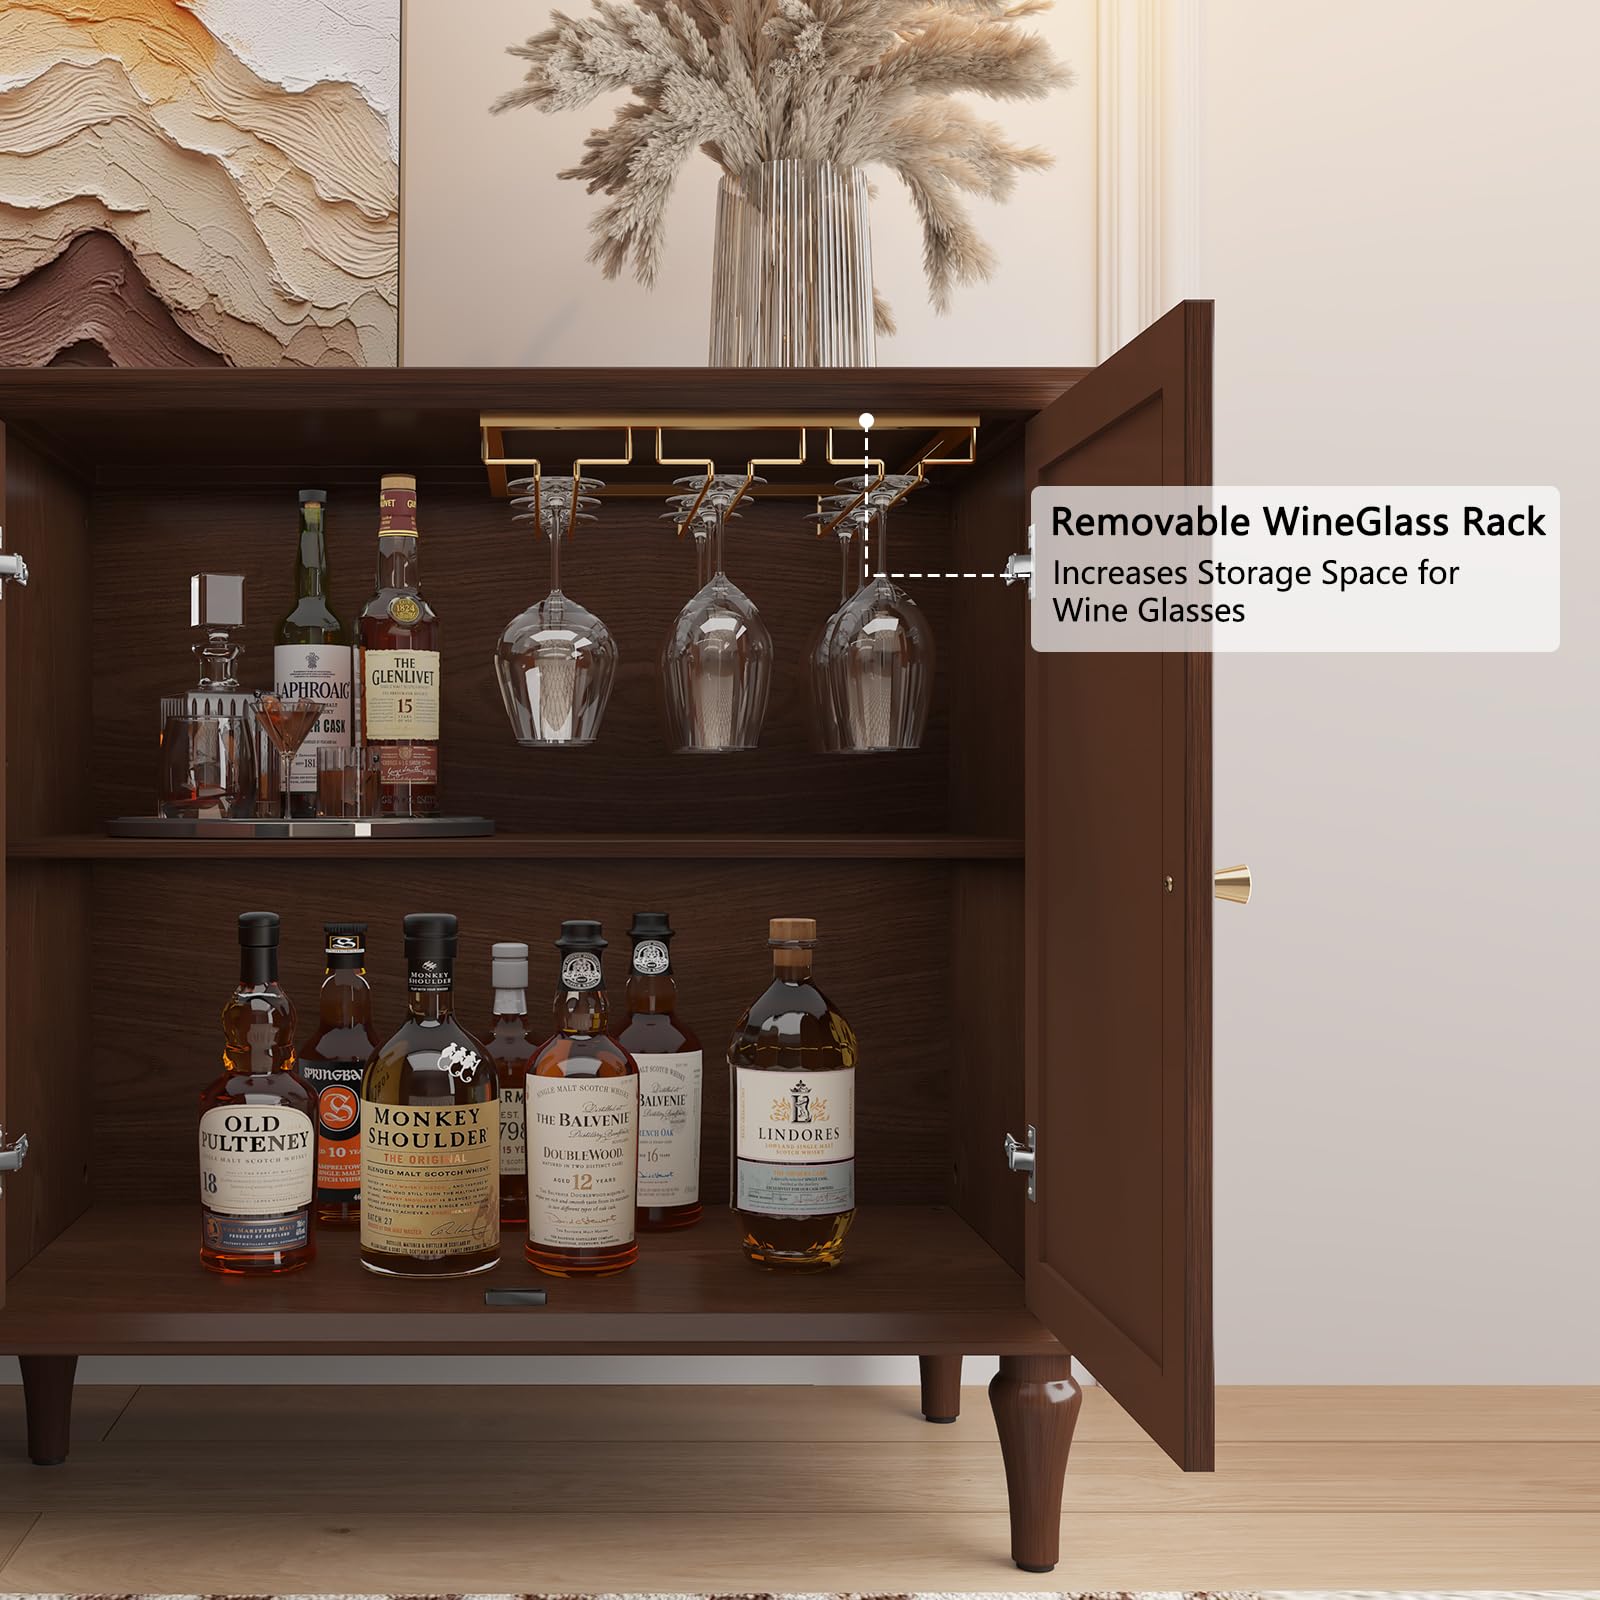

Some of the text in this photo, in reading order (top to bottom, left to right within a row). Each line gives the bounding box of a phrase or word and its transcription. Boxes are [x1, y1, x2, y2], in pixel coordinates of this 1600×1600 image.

[396, 604, 416, 612] 1824
[394, 658, 416, 668] THE
[372, 670, 434, 686] GLENLIVET
[398, 698, 413, 713] 15
[324, 720, 346, 733] CASK
[579, 1084, 609, 1093] SCOTCH
[224, 1116, 280, 1132] OLD
[374, 1107, 480, 1127] MONKEY
[536, 1112, 630, 1128] THE BALVENIE
[368, 1127, 488, 1148] SHOULDER
[660, 1128, 673, 1137] OAK
[758, 1127, 840, 1141] LINDORES
[201, 1130, 310, 1152] PULTENEY
[328, 1147, 346, 1158] 10
[384, 1153, 466, 1164] THE ORIGINAL
[647, 1148, 659, 1162] 16
[367, 1165, 394, 1175] BLENDED
[465, 1166, 489, 1174] WHISKY
[203, 1171, 218, 1194] 18
[572, 1173, 592, 1190] 12
